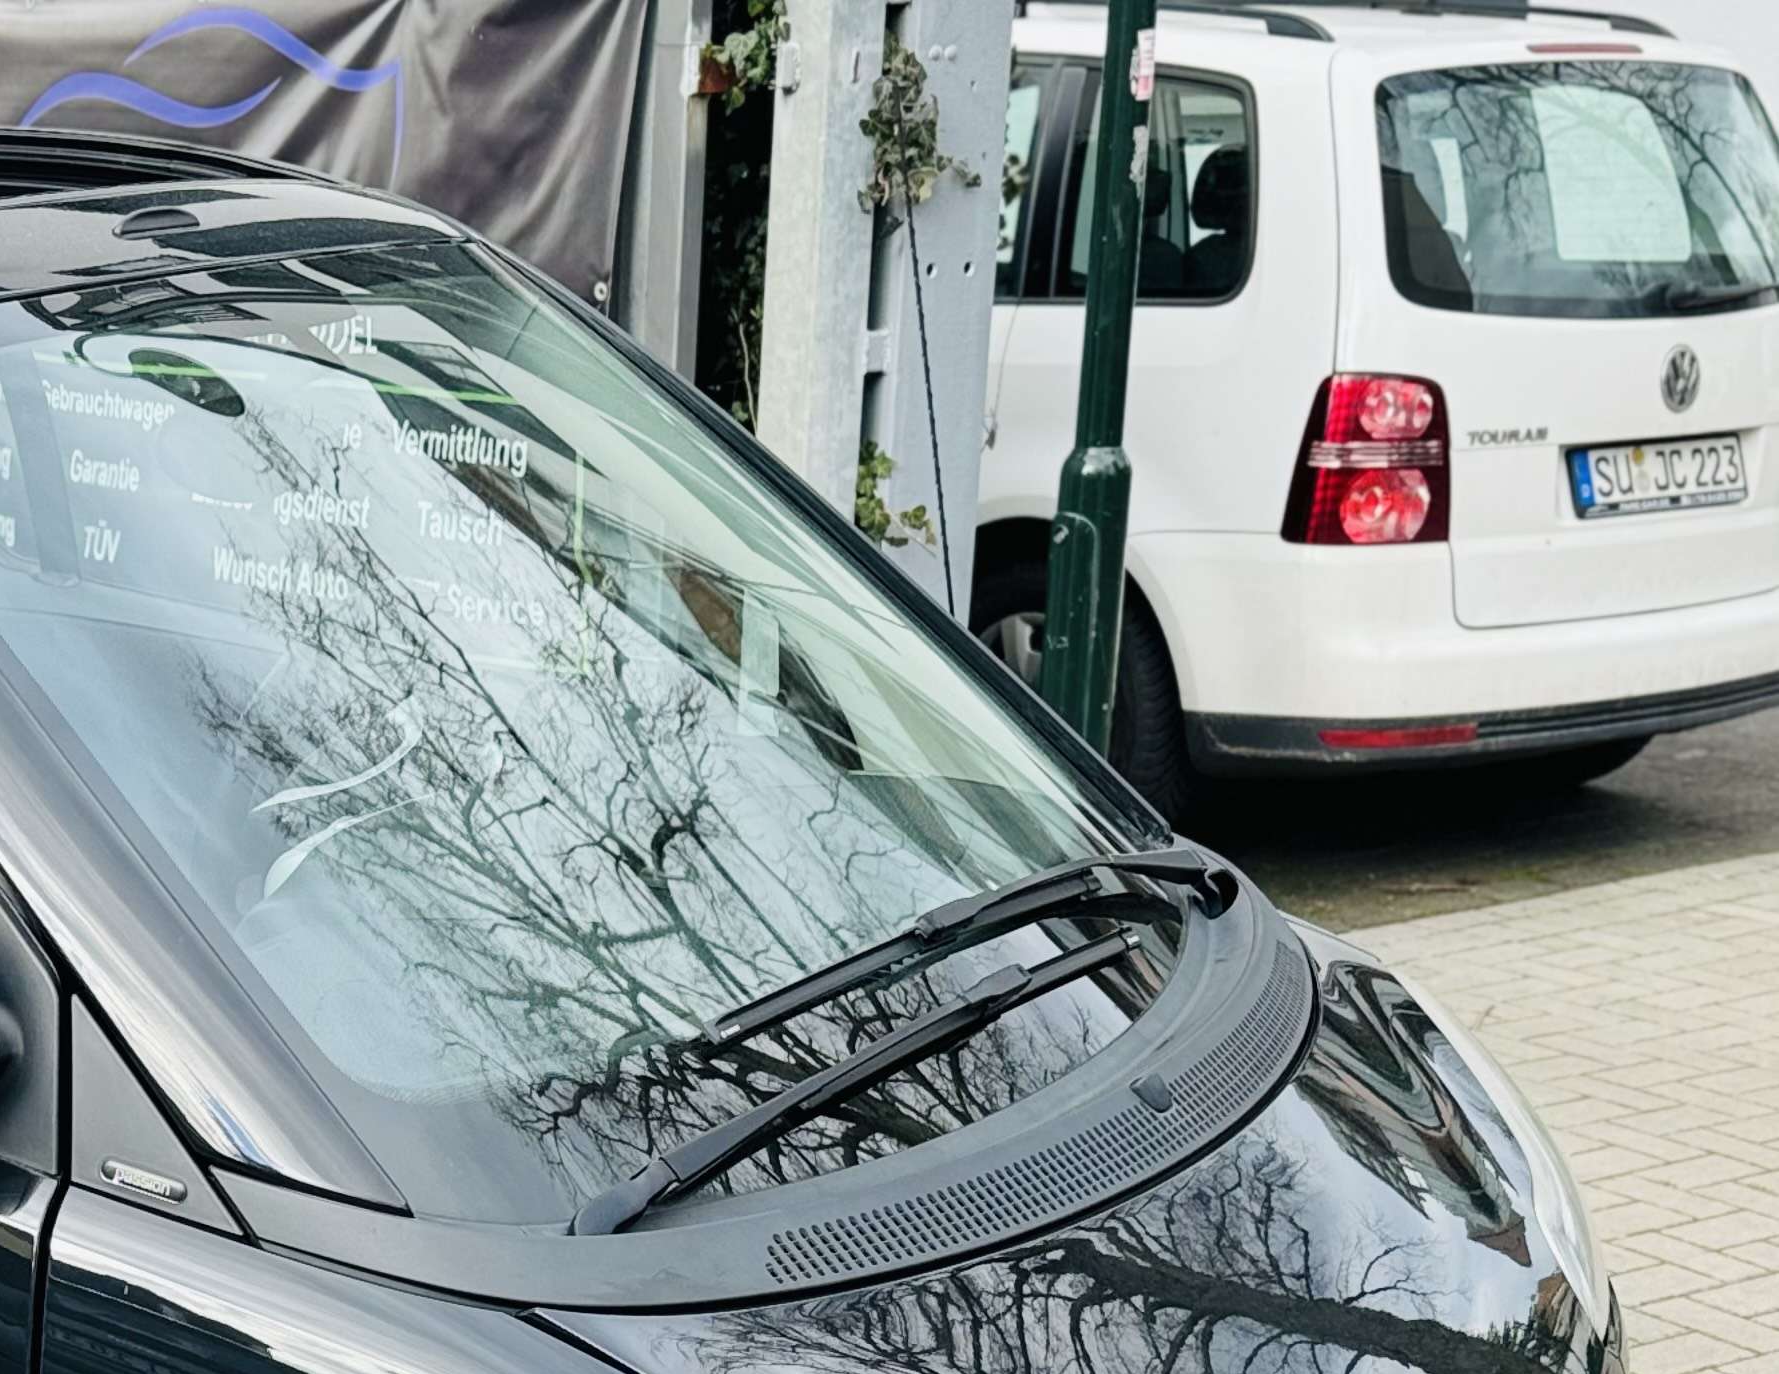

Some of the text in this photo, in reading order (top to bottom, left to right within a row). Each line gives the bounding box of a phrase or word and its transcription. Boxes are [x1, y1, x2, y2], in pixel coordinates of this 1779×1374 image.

[70, 448, 140, 493] Garantie
[392, 419, 528, 478] Vermittlung
[1595, 455, 1635, 498] SU
[1654, 450, 1688, 491] JC
[1690, 445, 1740, 487] 223
[273, 485, 370, 529] gsdienst
[419, 501, 504, 547] Tausch
[83, 519, 122, 564] TÜV
[213, 545, 349, 600] Wunsch Auto
[447, 583, 545, 626] Service
